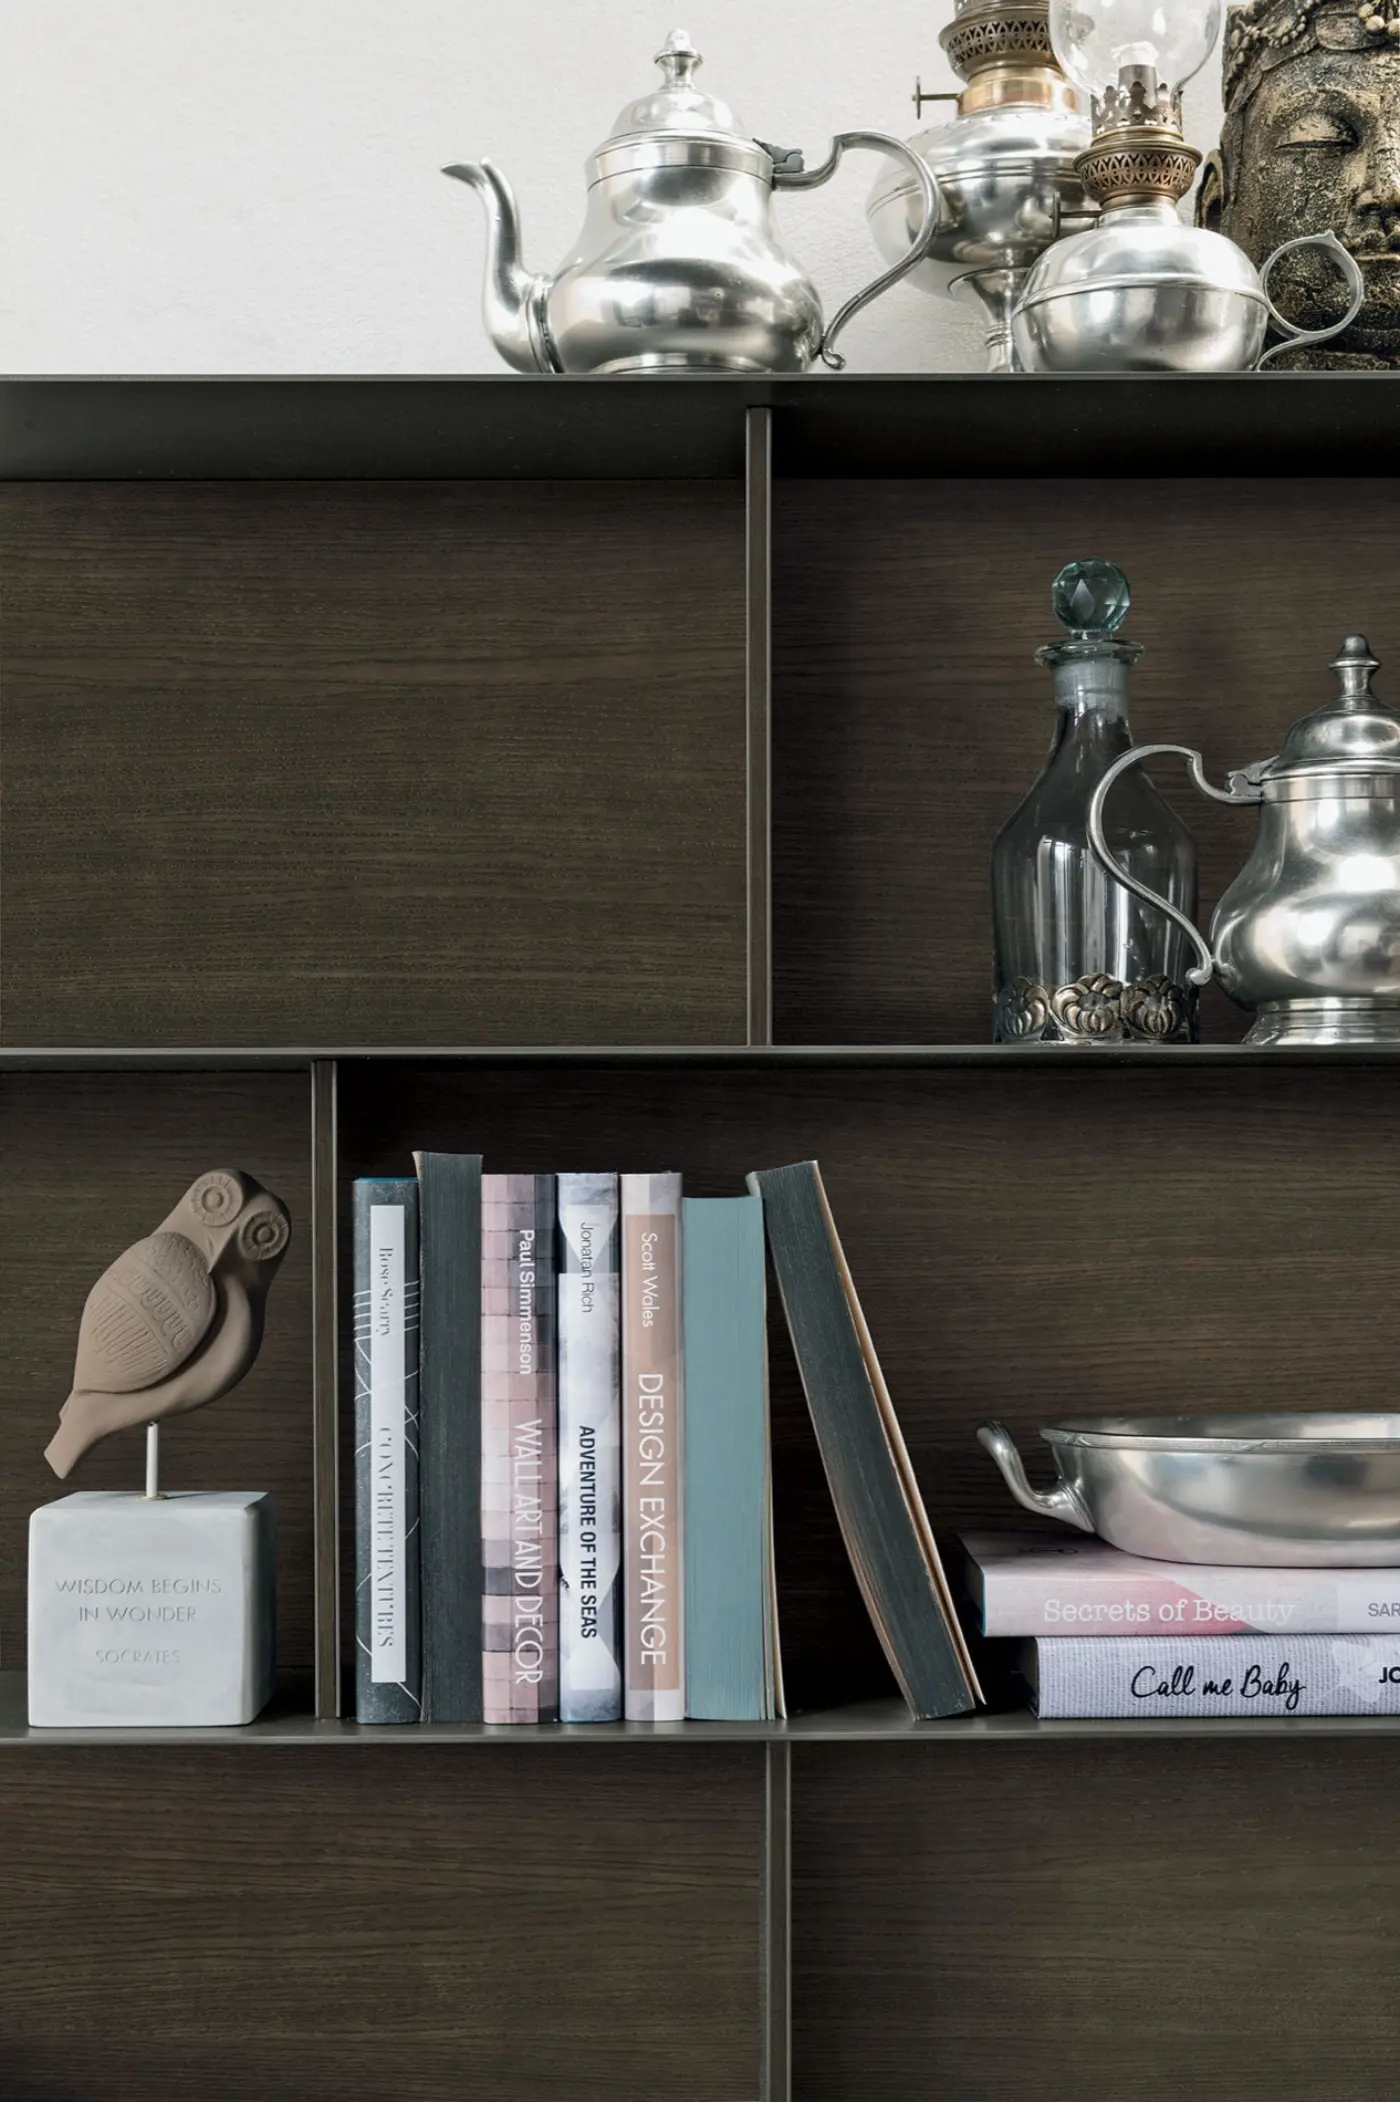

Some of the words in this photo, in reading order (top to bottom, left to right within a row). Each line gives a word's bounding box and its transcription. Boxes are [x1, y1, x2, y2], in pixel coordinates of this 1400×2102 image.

[378, 1247, 394, 1285] Rose
[519, 1229, 536, 1269] Paul
[580, 1222, 595, 1278] Jonatan
[641, 1232, 659, 1270] Scott
[581, 1282, 596, 1313] Rich
[642, 1275, 660, 1328] Wales
[519, 1271, 536, 1375] Simmenson
[638, 1373, 665, 1486] DESIGN
[514, 1419, 543, 1487] WALL
[579, 1425, 597, 1526] ADVENTURE
[376, 1427, 395, 1541] CONCRETE
[514, 1494, 543, 1534] ART
[514, 1540, 543, 1588] AND
[580, 1531, 597, 1553] OF
[55, 1578, 144, 1595] WISDOM
[151, 1578, 223, 1594] BEGINS
[580, 1556, 597, 1590] THE
[639, 1497, 667, 1665] EXCHANGE
[79, 1606, 99, 1623] IN
[106, 1606, 197, 1622] WONDER
[376, 1545, 395, 1648] TEXTURES
[580, 1594, 598, 1639] SEAS
[1043, 1599, 1150, 1622] Secrets
[1158, 1599, 1188, 1622] of
[1193, 1599, 1296, 1626] Beauty
[95, 1650, 181, 1664] SOCRATES
[515, 1596, 544, 1685] DECOR
[1130, 1664, 1197, 1699] Call
[1201, 1680, 1234, 1697] me
[1239, 1661, 1307, 1711] Baby
